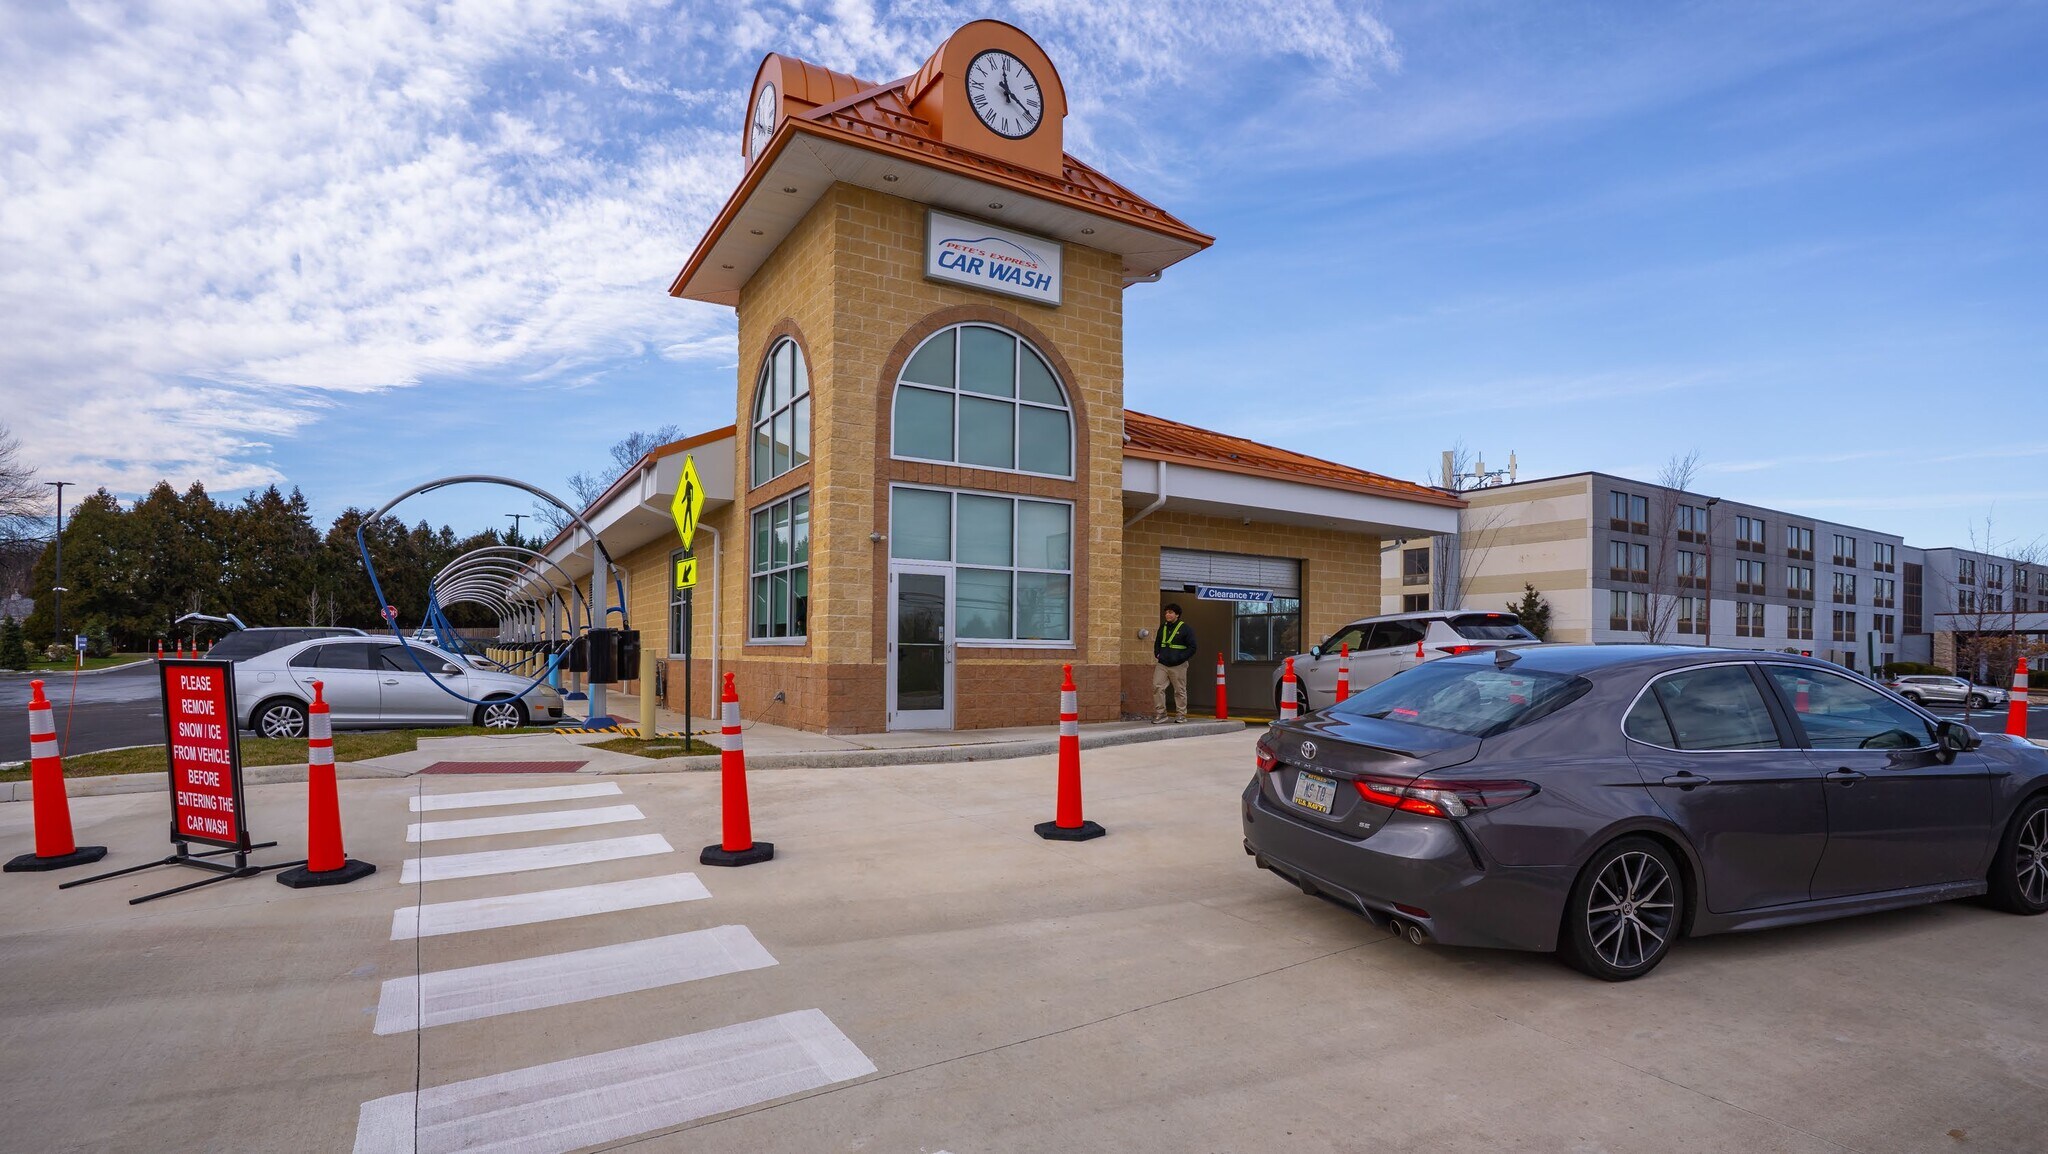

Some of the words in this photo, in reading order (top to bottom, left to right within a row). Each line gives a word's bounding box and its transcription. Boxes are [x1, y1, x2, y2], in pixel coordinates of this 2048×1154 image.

[946, 242, 986, 257] PETE'S
[990, 252, 1038, 270] EXPRESS
[938, 250, 984, 276] CAR
[989, 261, 1052, 292] WASH
[1208, 589, 1248, 600] Clearance
[180, 675, 212, 691] PLEASE
[181, 699, 215, 716] REMOVE
[179, 722, 204, 738] SNOW
[208, 724, 222, 740] ICE
[174, 744, 197, 760] FROM
[197, 746, 231, 764] VEHICLE
[188, 769, 220, 787] BEFORE
[177, 791, 217, 810] ENTERING
[217, 796, 234, 812] THE
[187, 815, 204, 831] CAR
[204, 817, 228, 835] WASH
